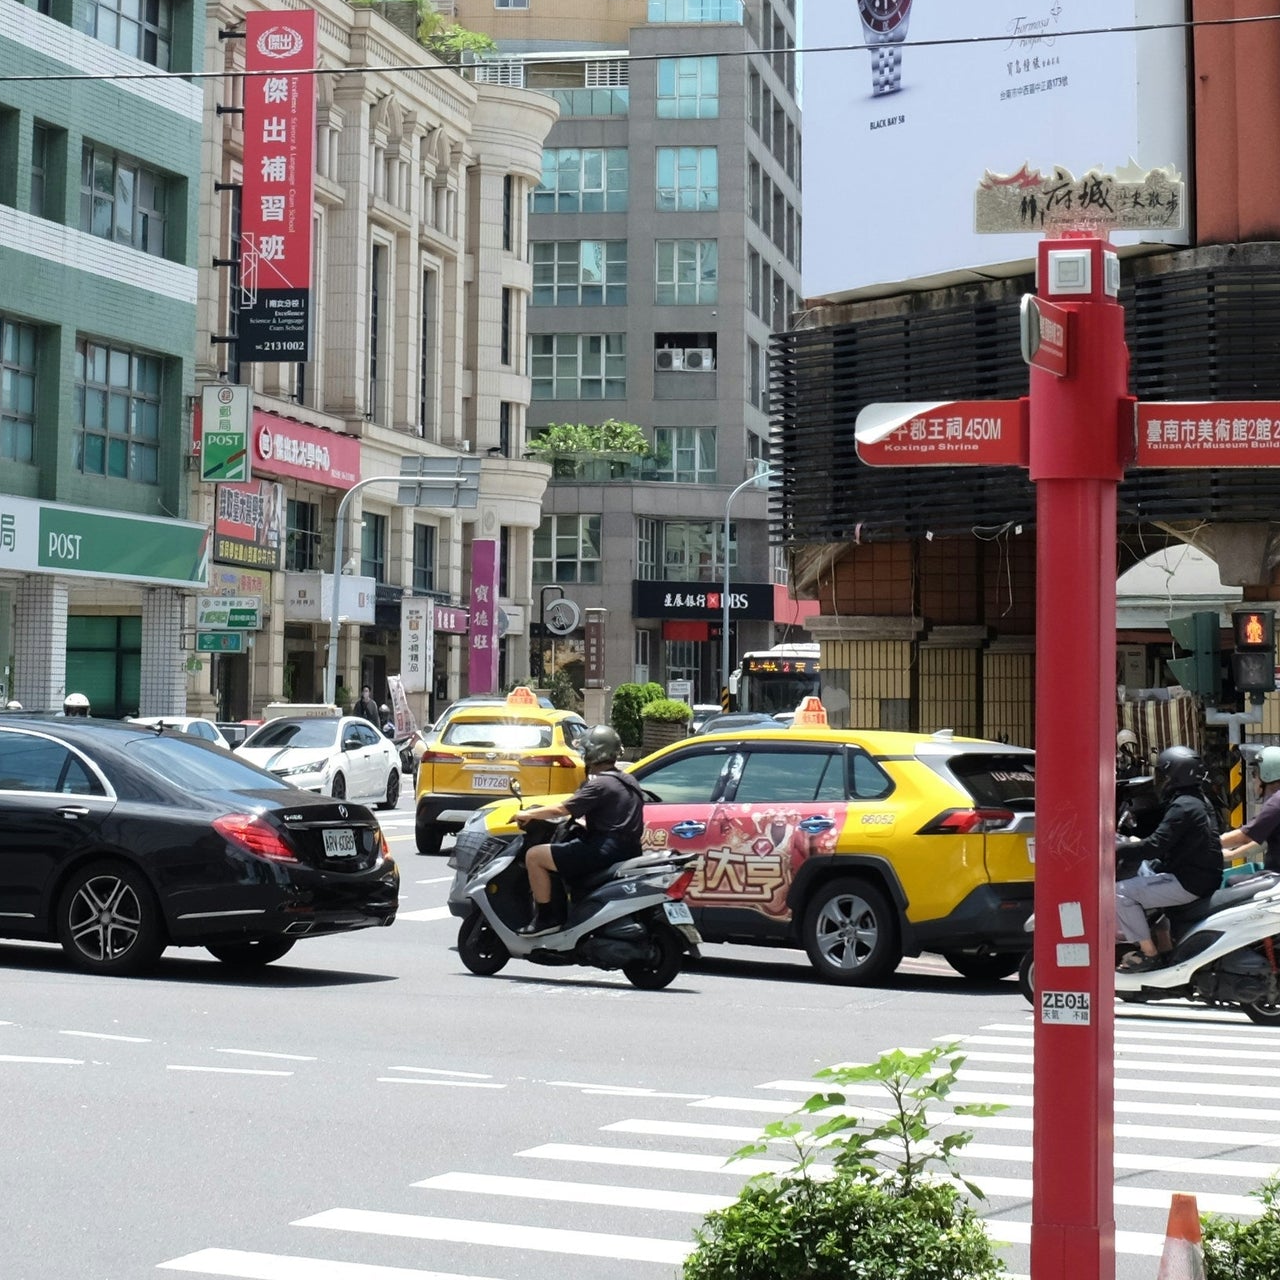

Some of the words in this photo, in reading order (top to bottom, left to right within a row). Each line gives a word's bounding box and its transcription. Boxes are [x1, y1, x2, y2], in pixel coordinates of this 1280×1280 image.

[259, 77, 288, 261] 傑出補習班
[264, 342, 304, 351] 2131002
[219, 406, 232, 431] 郵局
[882, 417, 963, 441] 平郡王祠
[964, 418, 1001, 440] 450M
[1146, 418, 1272, 443] 臺南市美術館2館
[208, 435, 241, 446] POST
[884, 444, 935, 452] Koxinga
[49, 531, 83, 560] POST
[861, 815, 896, 824] 66052
